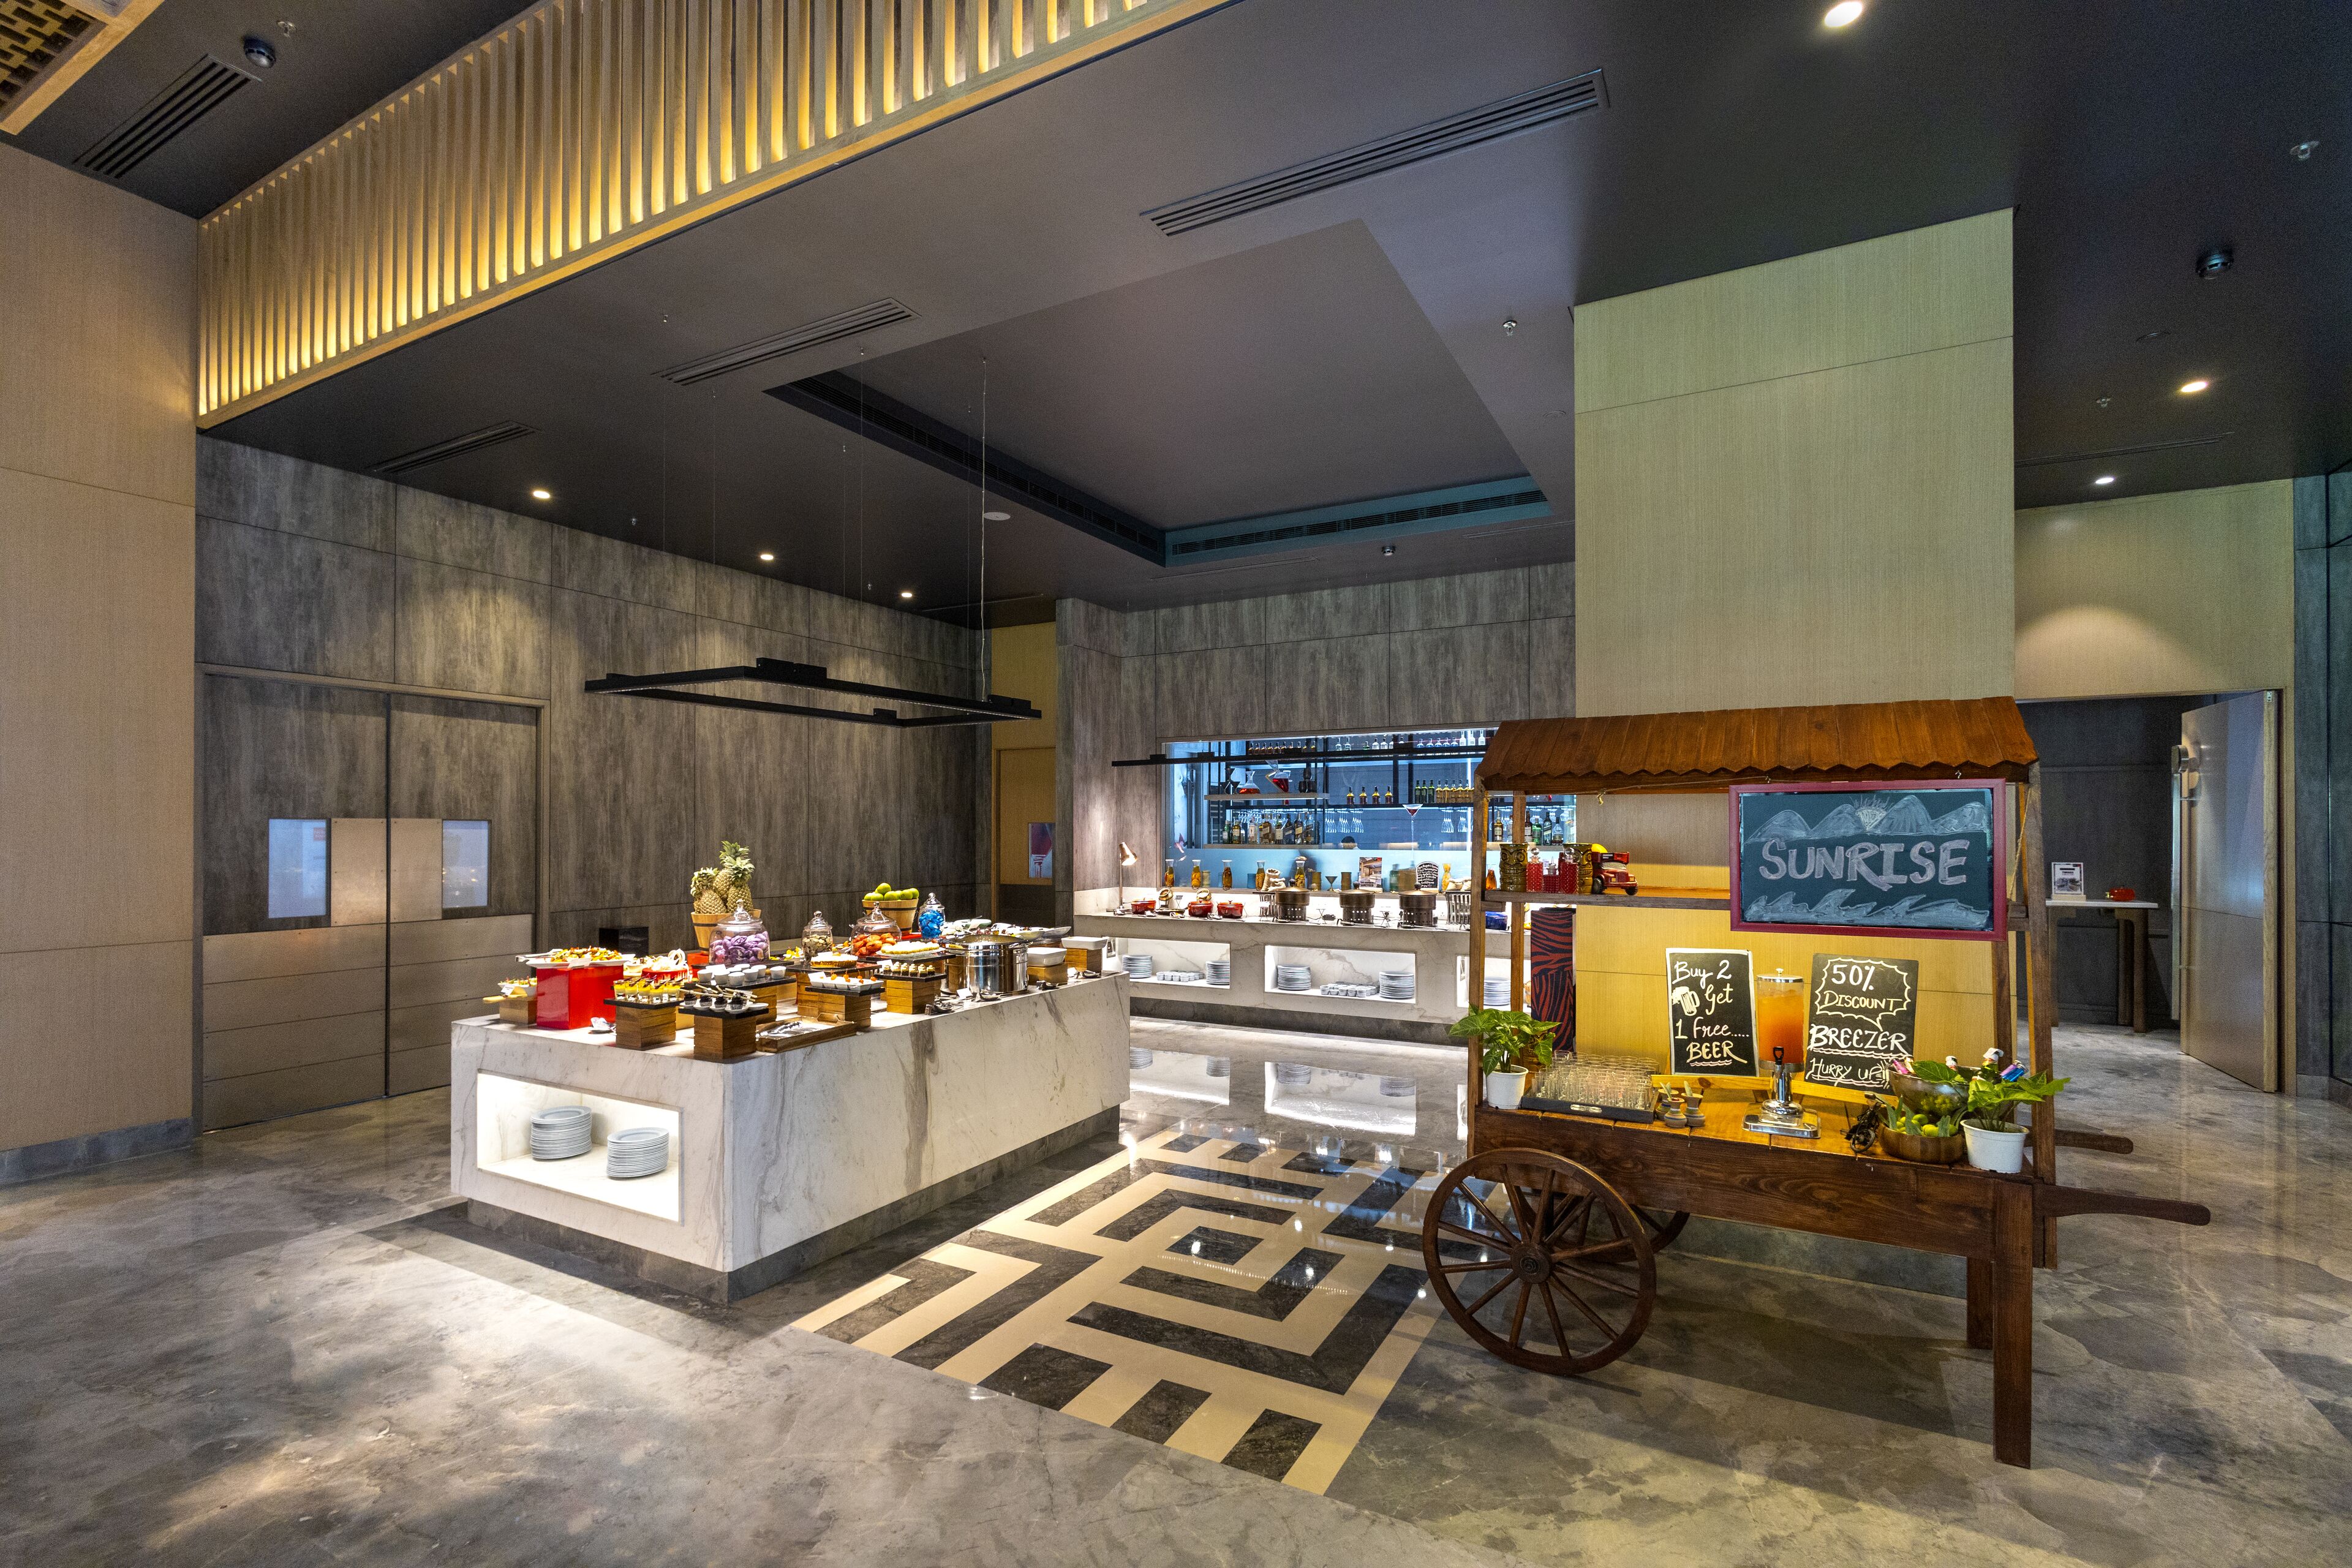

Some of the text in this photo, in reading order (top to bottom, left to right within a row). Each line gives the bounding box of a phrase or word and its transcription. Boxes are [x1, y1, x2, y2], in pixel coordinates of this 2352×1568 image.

[1759, 839, 1970, 891] SUNRISE
[1672, 959, 1732, 989] Buy 2
[1831, 964, 1875, 992] 50%
[1704, 983, 1733, 1016] Get
[1820, 990, 1903, 1011] DISCOUNT
[1675, 1019, 1688, 1039] 1
[1807, 1023, 1910, 1055] BREEZER
[1686, 1041, 1748, 1064] BEER
[1805, 1057, 1852, 1087] HURRY
